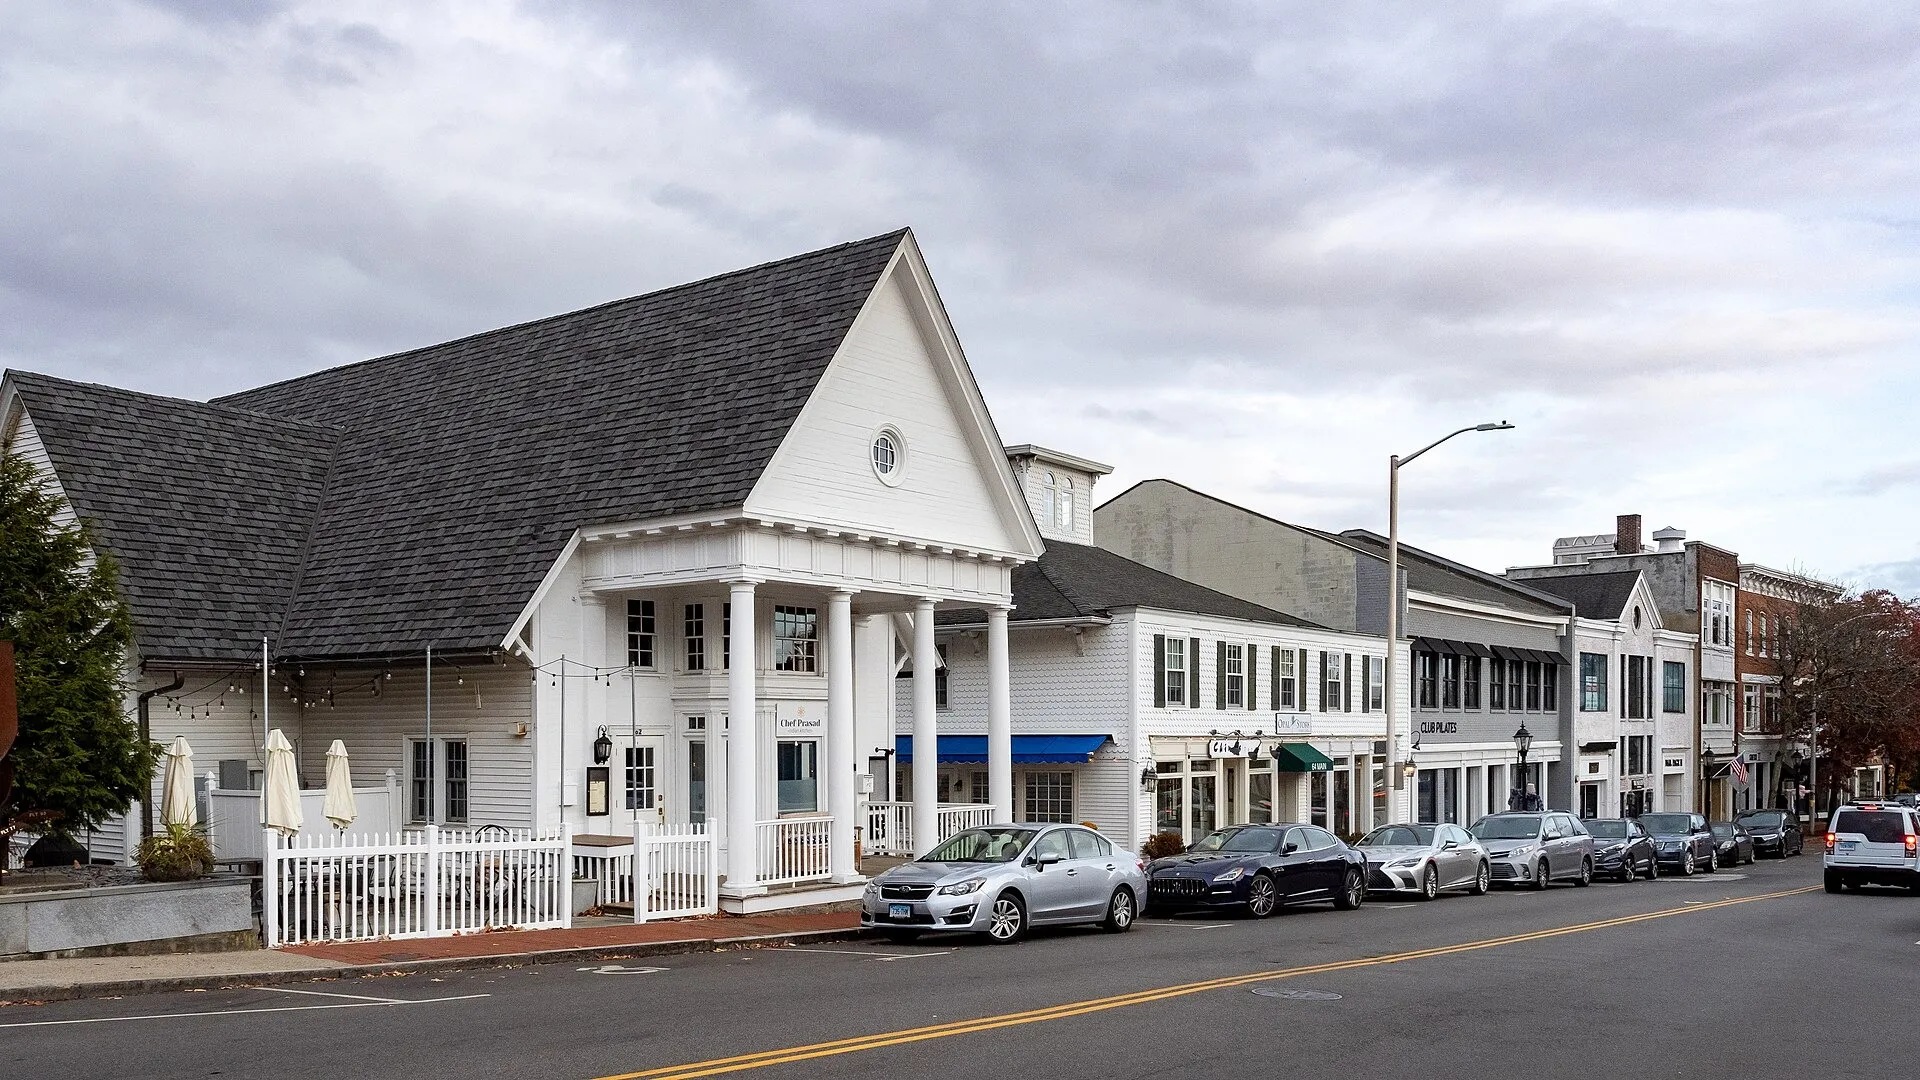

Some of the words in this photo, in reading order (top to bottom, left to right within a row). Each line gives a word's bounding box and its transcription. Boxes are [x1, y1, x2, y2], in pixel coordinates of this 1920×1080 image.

[780, 719, 797, 728] Chef
[797, 719, 821, 727] Prasad
[1420, 722, 1435, 733] CLUB
[1436, 721, 1457, 733] PILATES
